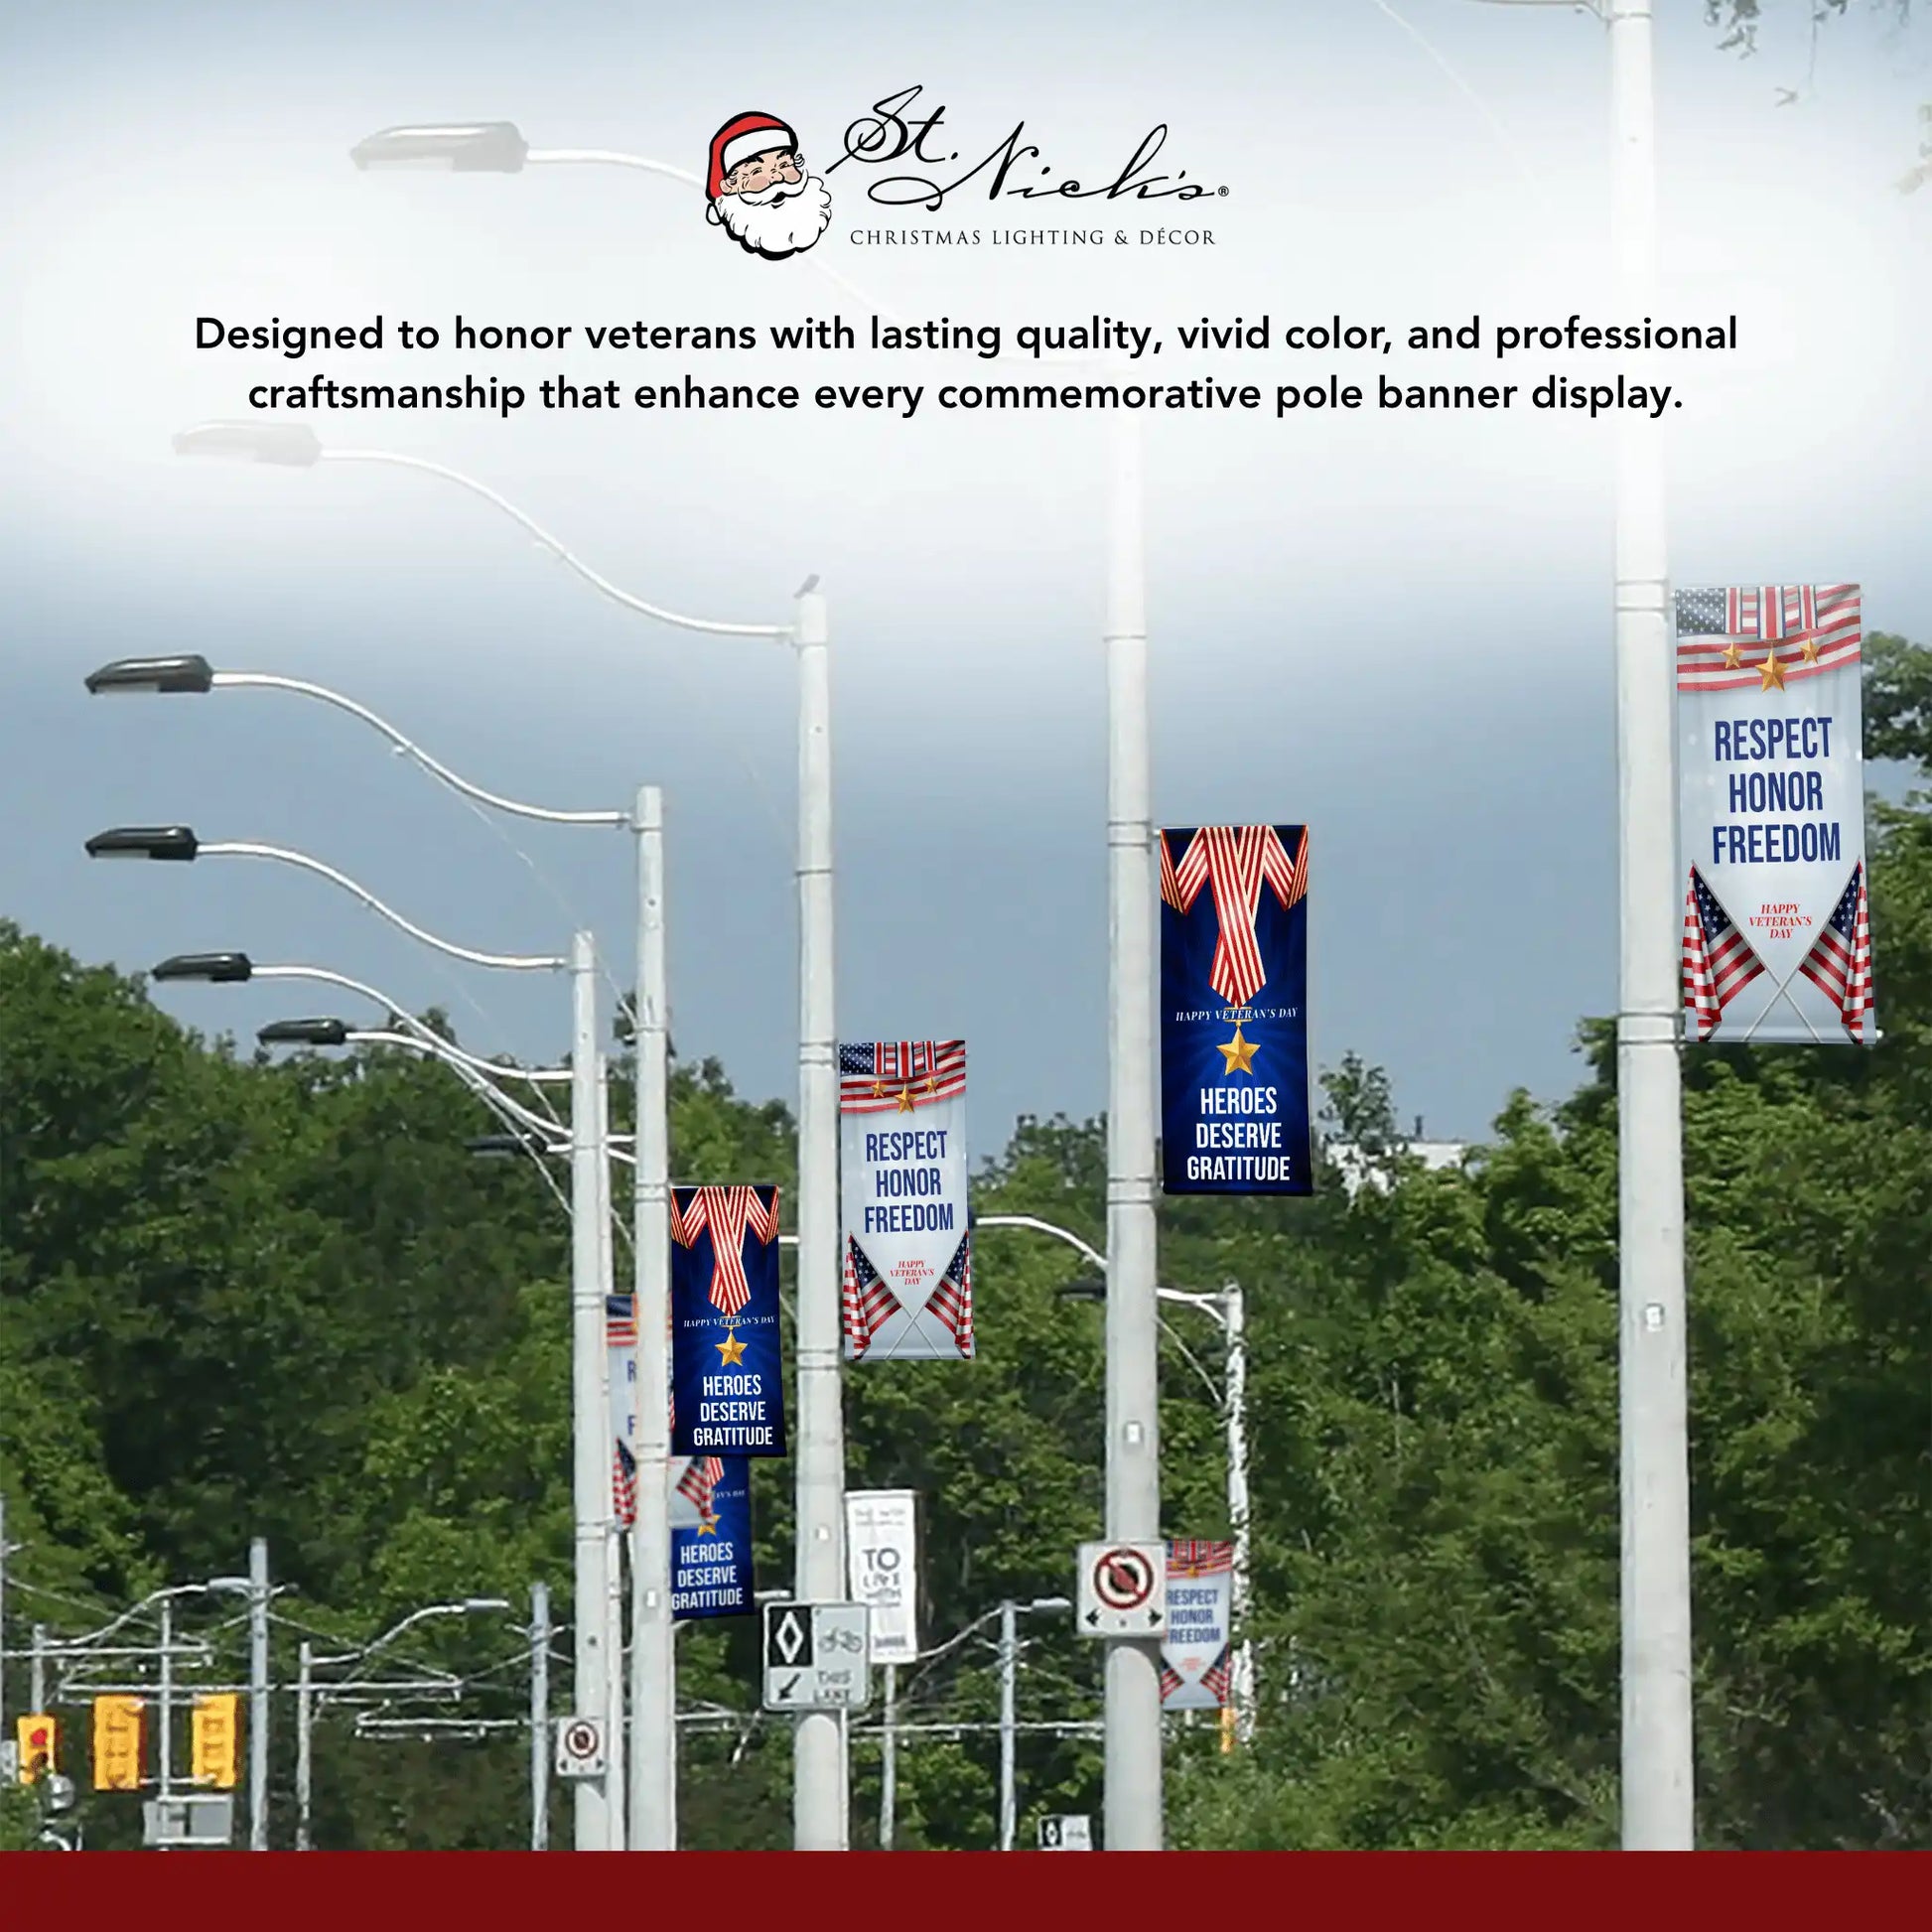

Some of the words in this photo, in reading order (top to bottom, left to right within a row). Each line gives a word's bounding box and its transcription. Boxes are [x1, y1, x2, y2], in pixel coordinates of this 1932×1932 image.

[1715, 717, 1833, 761] RESPECT
[1729, 770, 1823, 813] HONOR
[1713, 822, 1841, 865] FREEDOM
[1760, 903, 1800, 914] HAPPY
[1769, 928, 1793, 938] DAY
[1175, 1011, 1212, 1021] HAPPY
[1278, 1007, 1299, 1018] DAY
[1200, 1086, 1278, 1115] HEROES
[866, 1130, 947, 1162] RESPECT
[1195, 1122, 1282, 1149] DESERVE
[1186, 1156, 1291, 1181] GRATITUDE
[876, 1169, 941, 1197] HONOR
[865, 1203, 954, 1233] FREEDOM
[897, 1260, 925, 1269] HAPPY
[703, 1374, 762, 1397] HEROES
[700, 1401, 766, 1423] DESERVE
[693, 1426, 773, 1447] GRATITUDE
[680, 1542, 734, 1565] HEROES
[862, 1547, 901, 1572] TO
[677, 1565, 738, 1587] DESERVE
[671, 1587, 743, 1610] GRATITUDE
[1171, 1608, 1214, 1625] HONOR
[1168, 1627, 1221, 1644] REEDOM
